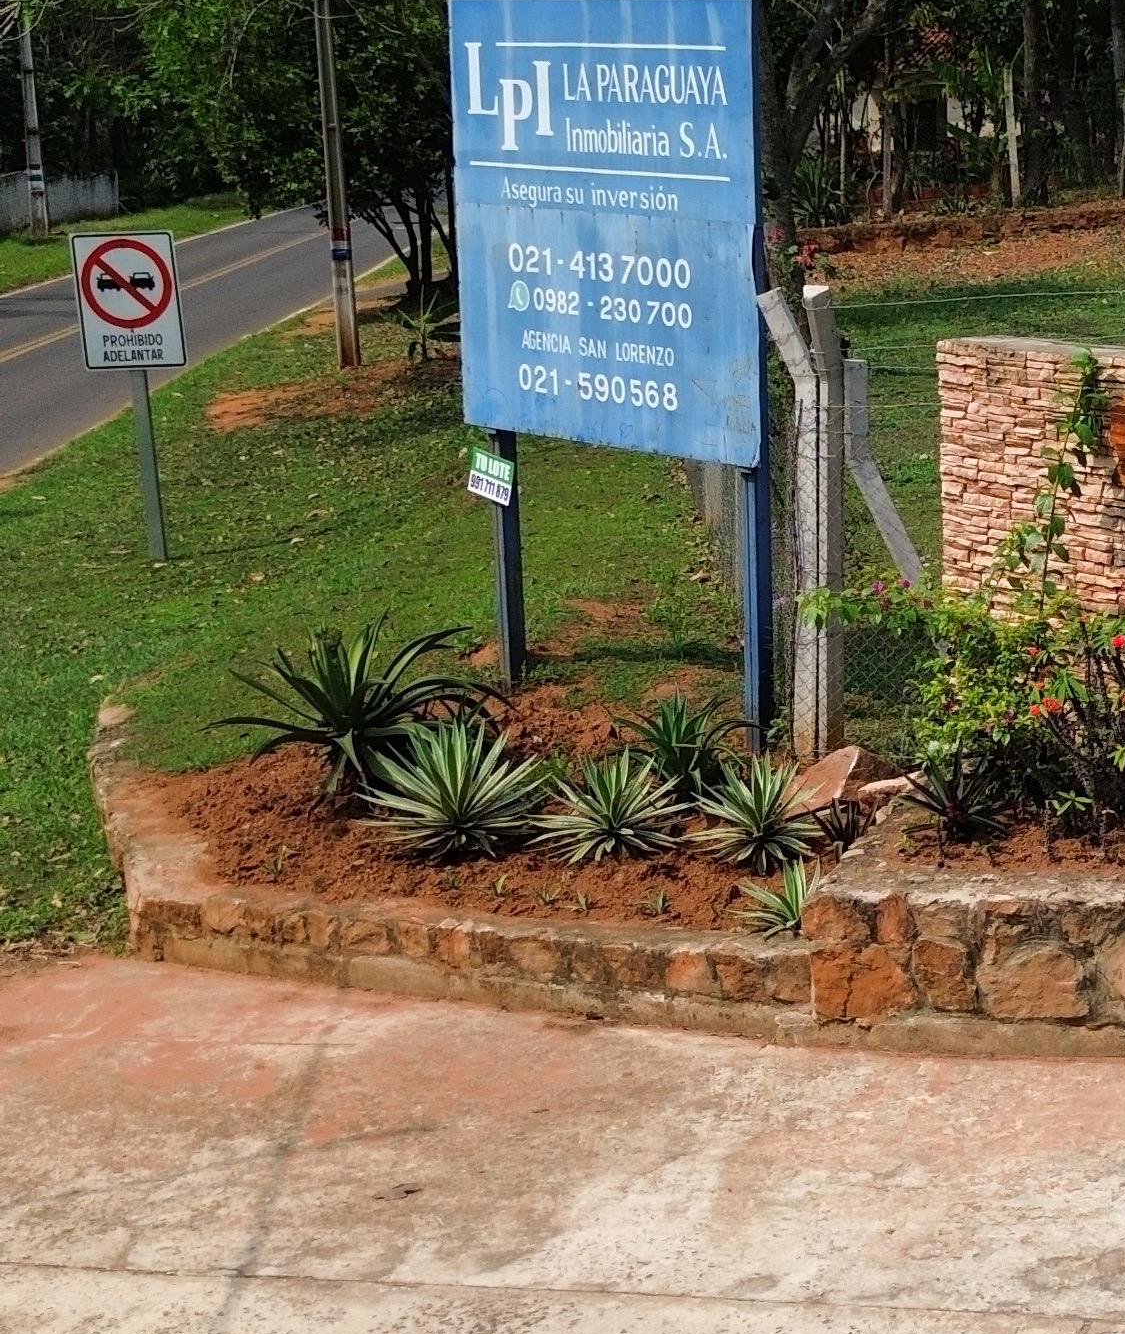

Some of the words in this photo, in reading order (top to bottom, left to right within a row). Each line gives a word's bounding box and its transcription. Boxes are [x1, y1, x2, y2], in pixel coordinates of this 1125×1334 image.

[464, 42, 555, 151] LPI
[563, 63, 592, 102] LA
[596, 64, 728, 106] PARAGUAYA
[565, 117, 670, 157] Inmobiliaria
[679, 122, 728, 160] S.A.
[501, 176, 562, 208] Asegura
[566, 185, 584, 205] su
[591, 182, 678, 212] inversión
[102, 333, 163, 348] PROHIBIDO
[103, 349, 164, 362] ADELANTAR
[521, 329, 572, 354] AGENCIA
[579, 336, 607, 358] SAN
[615, 342, 675, 367] LORENZO
[475, 452, 488, 472] TU
[487, 457, 511, 481] LOTE
